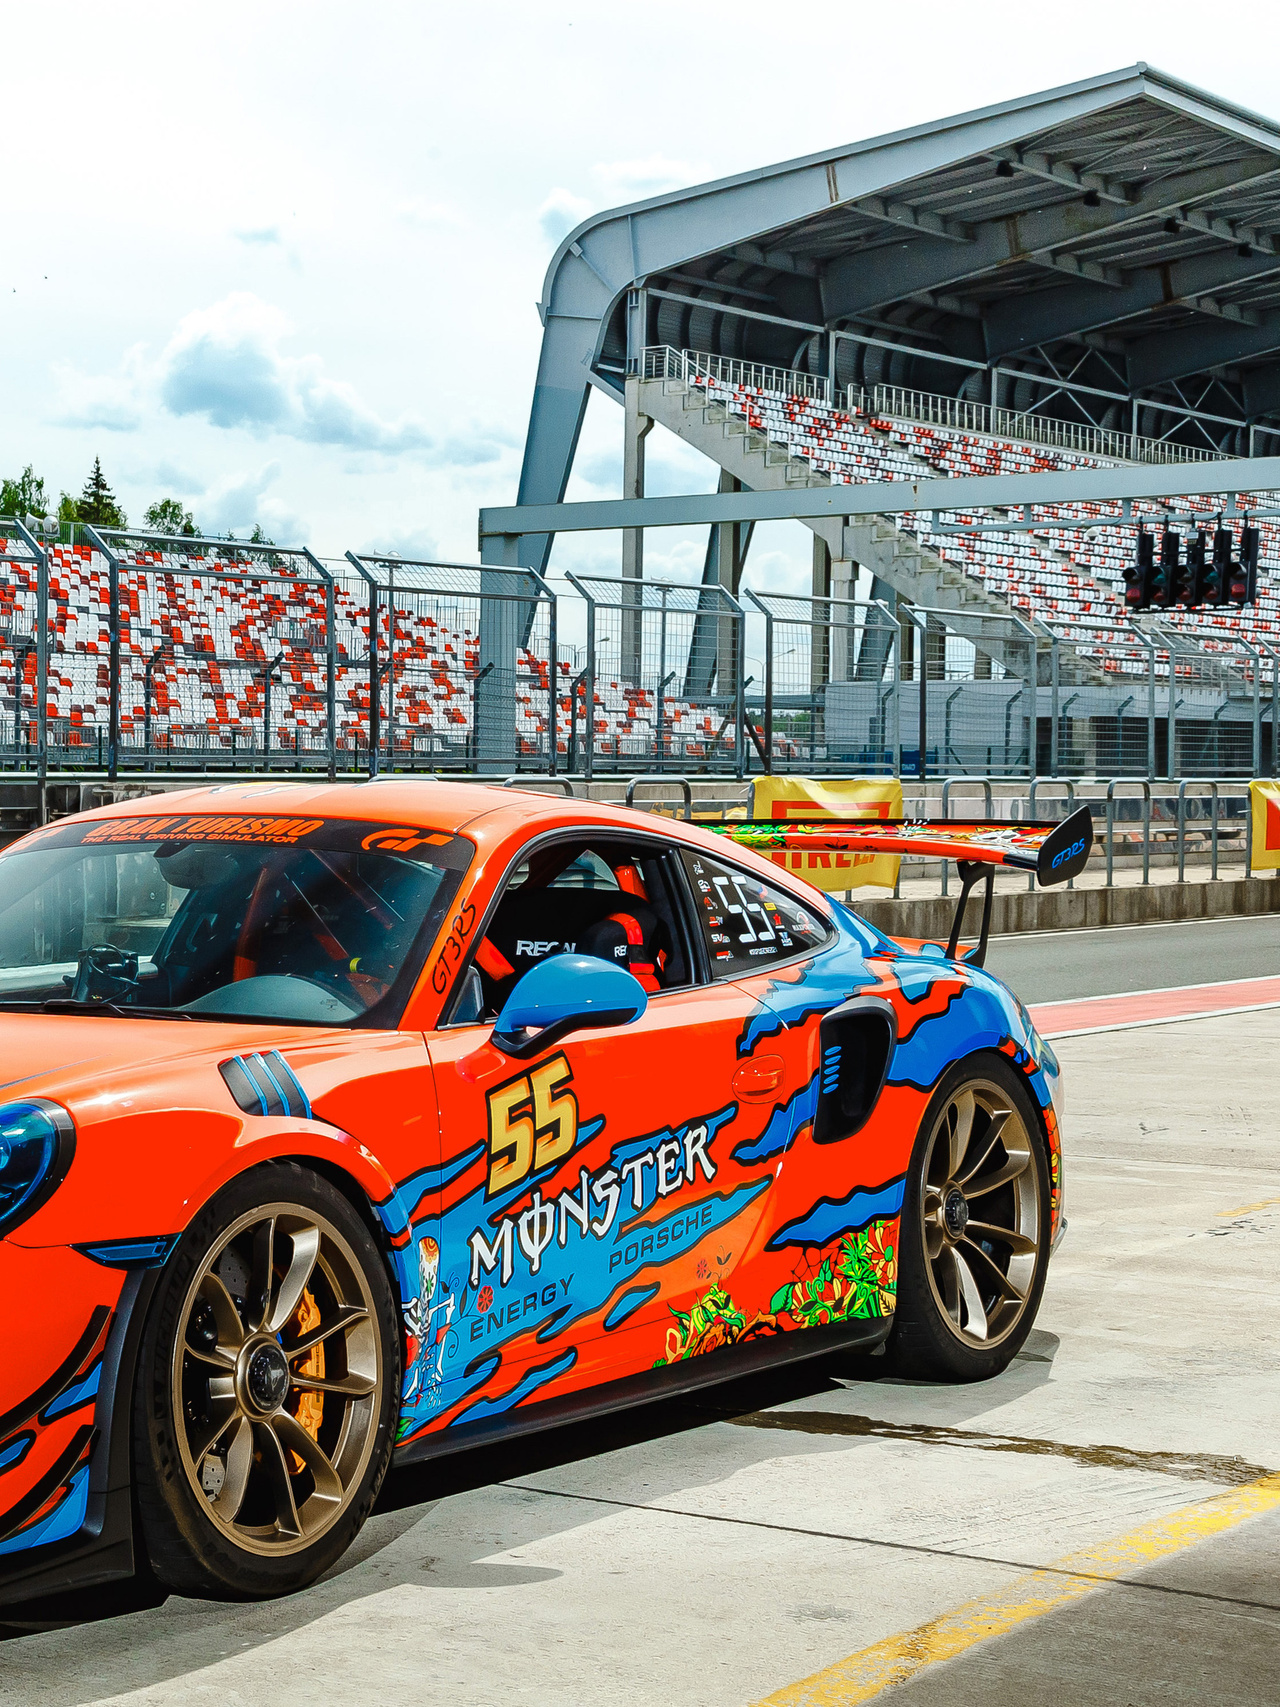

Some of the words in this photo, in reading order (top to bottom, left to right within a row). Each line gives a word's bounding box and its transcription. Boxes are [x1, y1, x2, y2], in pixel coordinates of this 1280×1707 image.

[86, 818, 181, 837] GRAN
[182, 817, 324, 836] TURISMO
[145, 833, 205, 841] DRIVING
[206, 834, 299, 843] SIMULATOR
[487, 1050, 578, 1194] 55
[609, 1204, 713, 1273] PORSCHE
[471, 1274, 574, 1342] ENERGY
